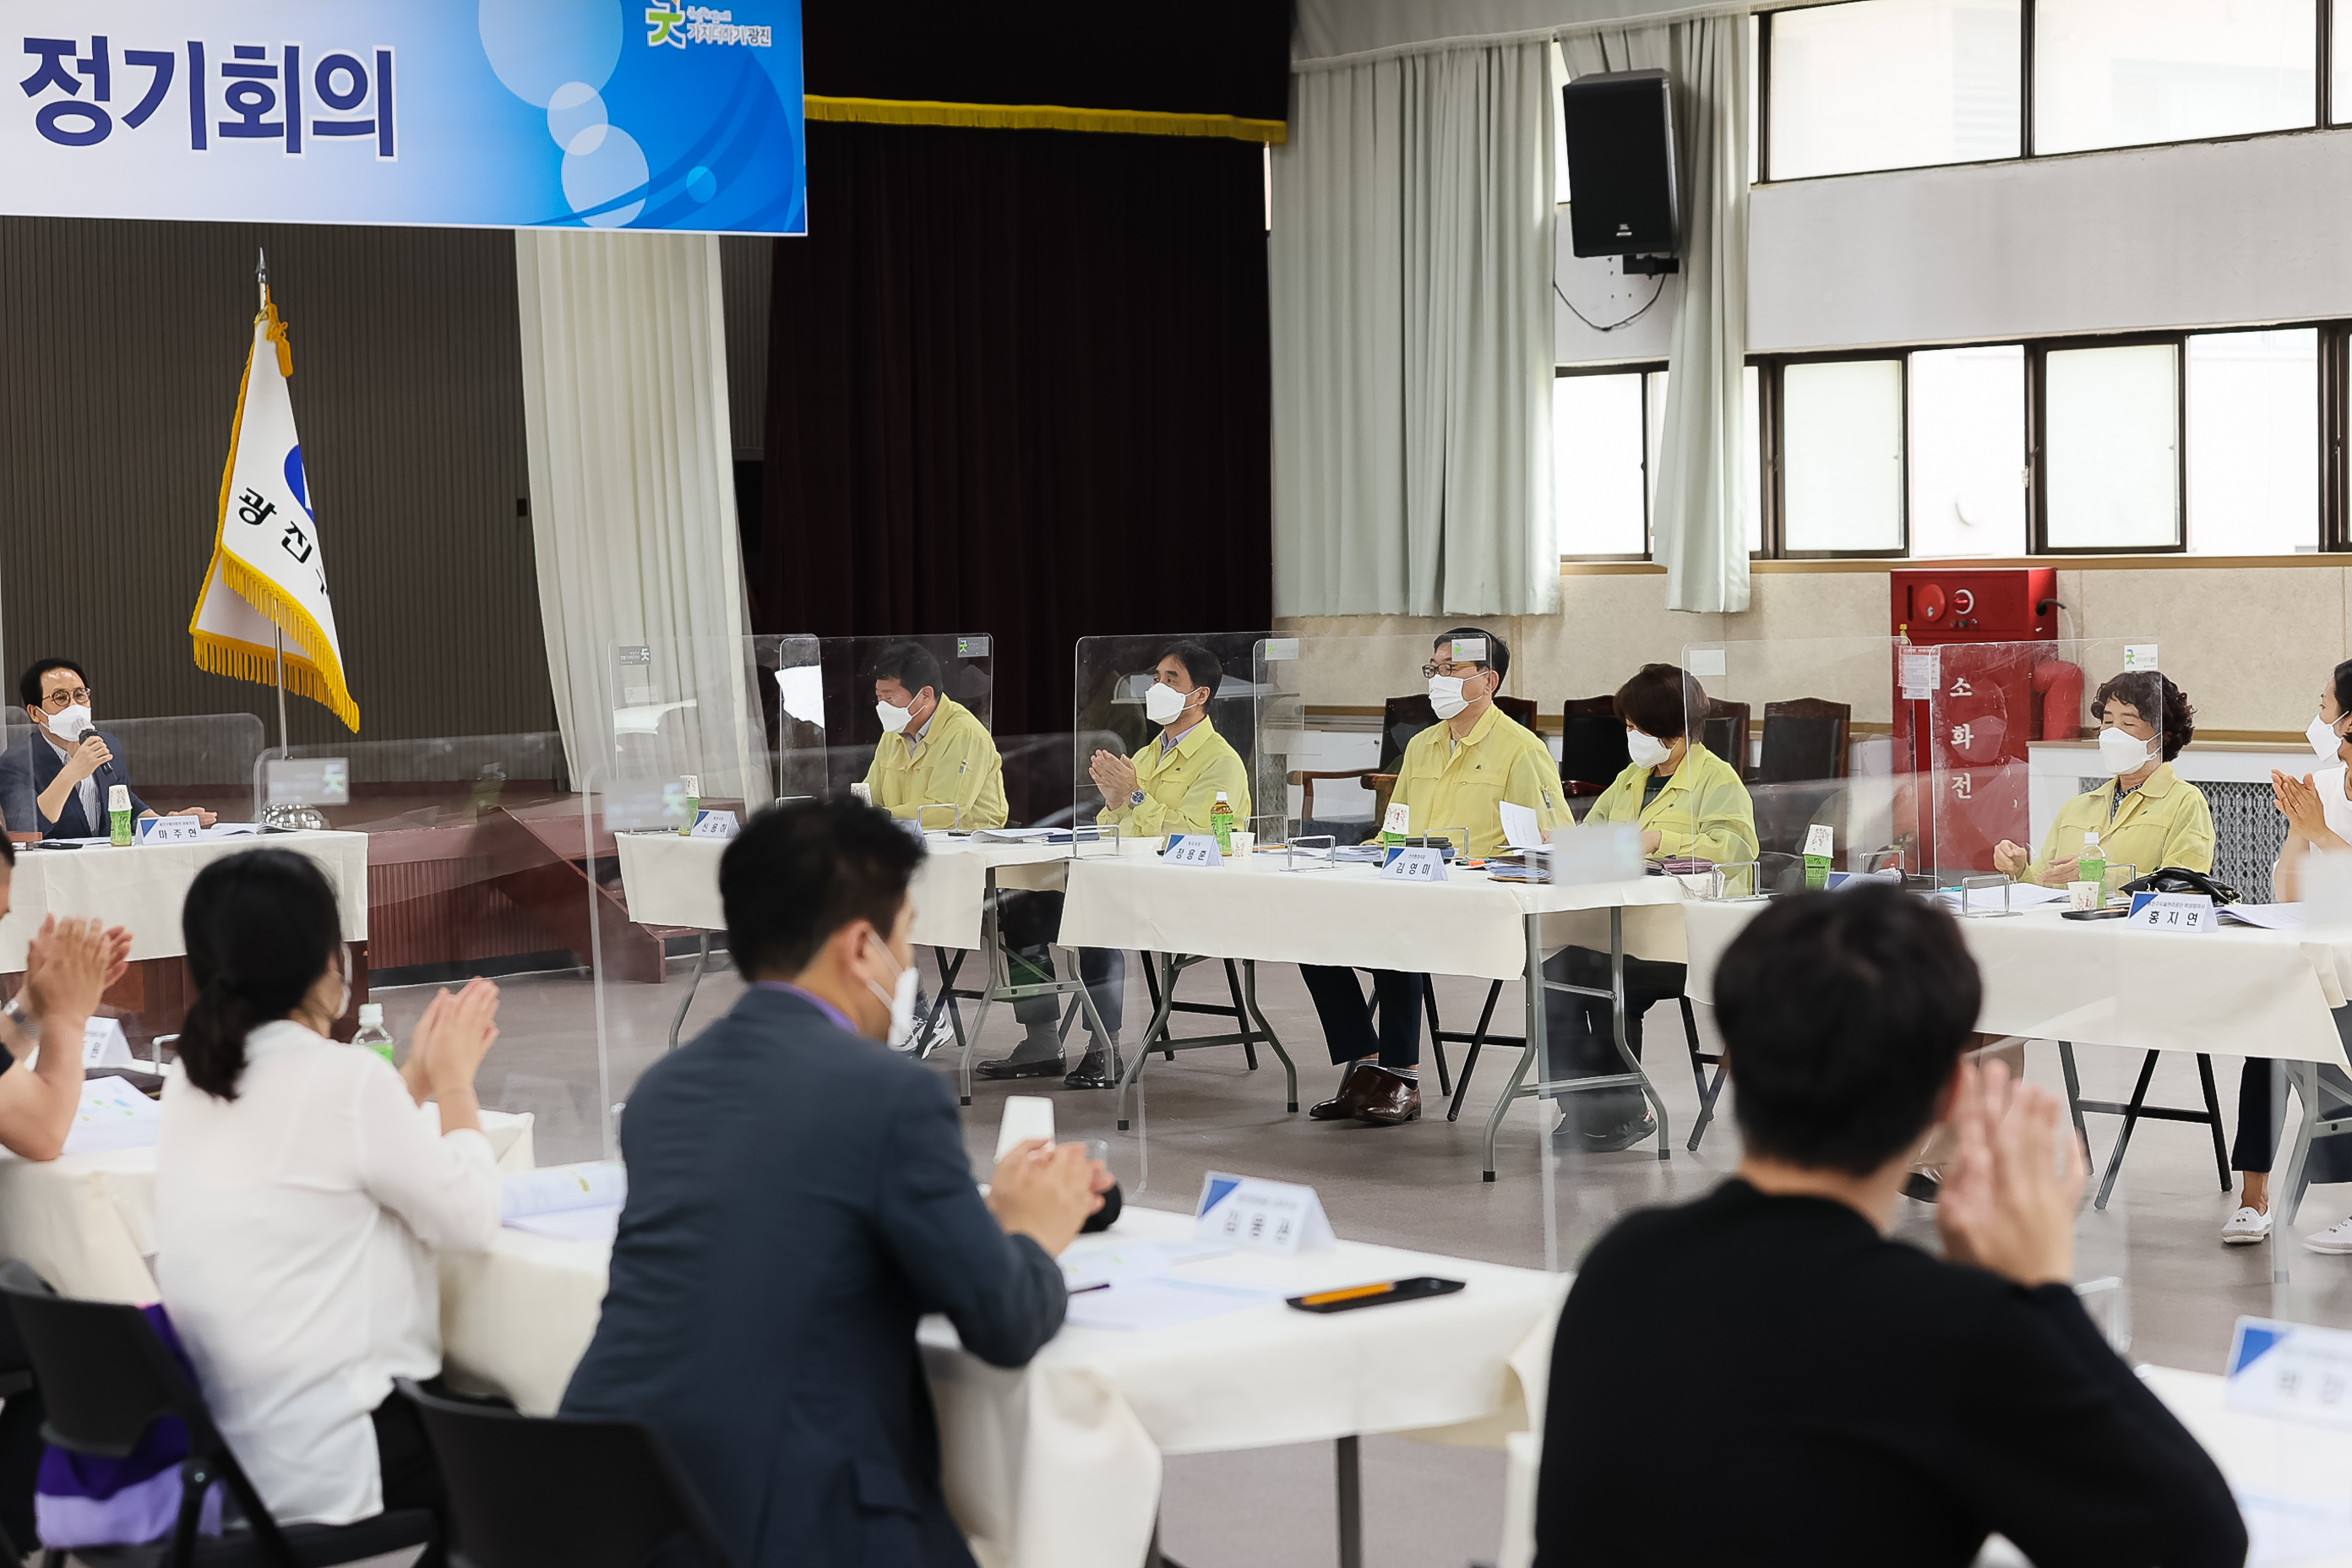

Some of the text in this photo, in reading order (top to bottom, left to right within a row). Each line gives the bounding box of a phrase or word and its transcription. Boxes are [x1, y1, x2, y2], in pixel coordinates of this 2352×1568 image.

[747, 26, 771, 46] 광진
[19, 35, 395, 157] 정기회의
[238, 487, 329, 595] 광진
[1949, 677, 1974, 799] 소화전
[1396, 862, 1431, 875] 김영미
[2148, 910, 2198, 927] 홍지연
